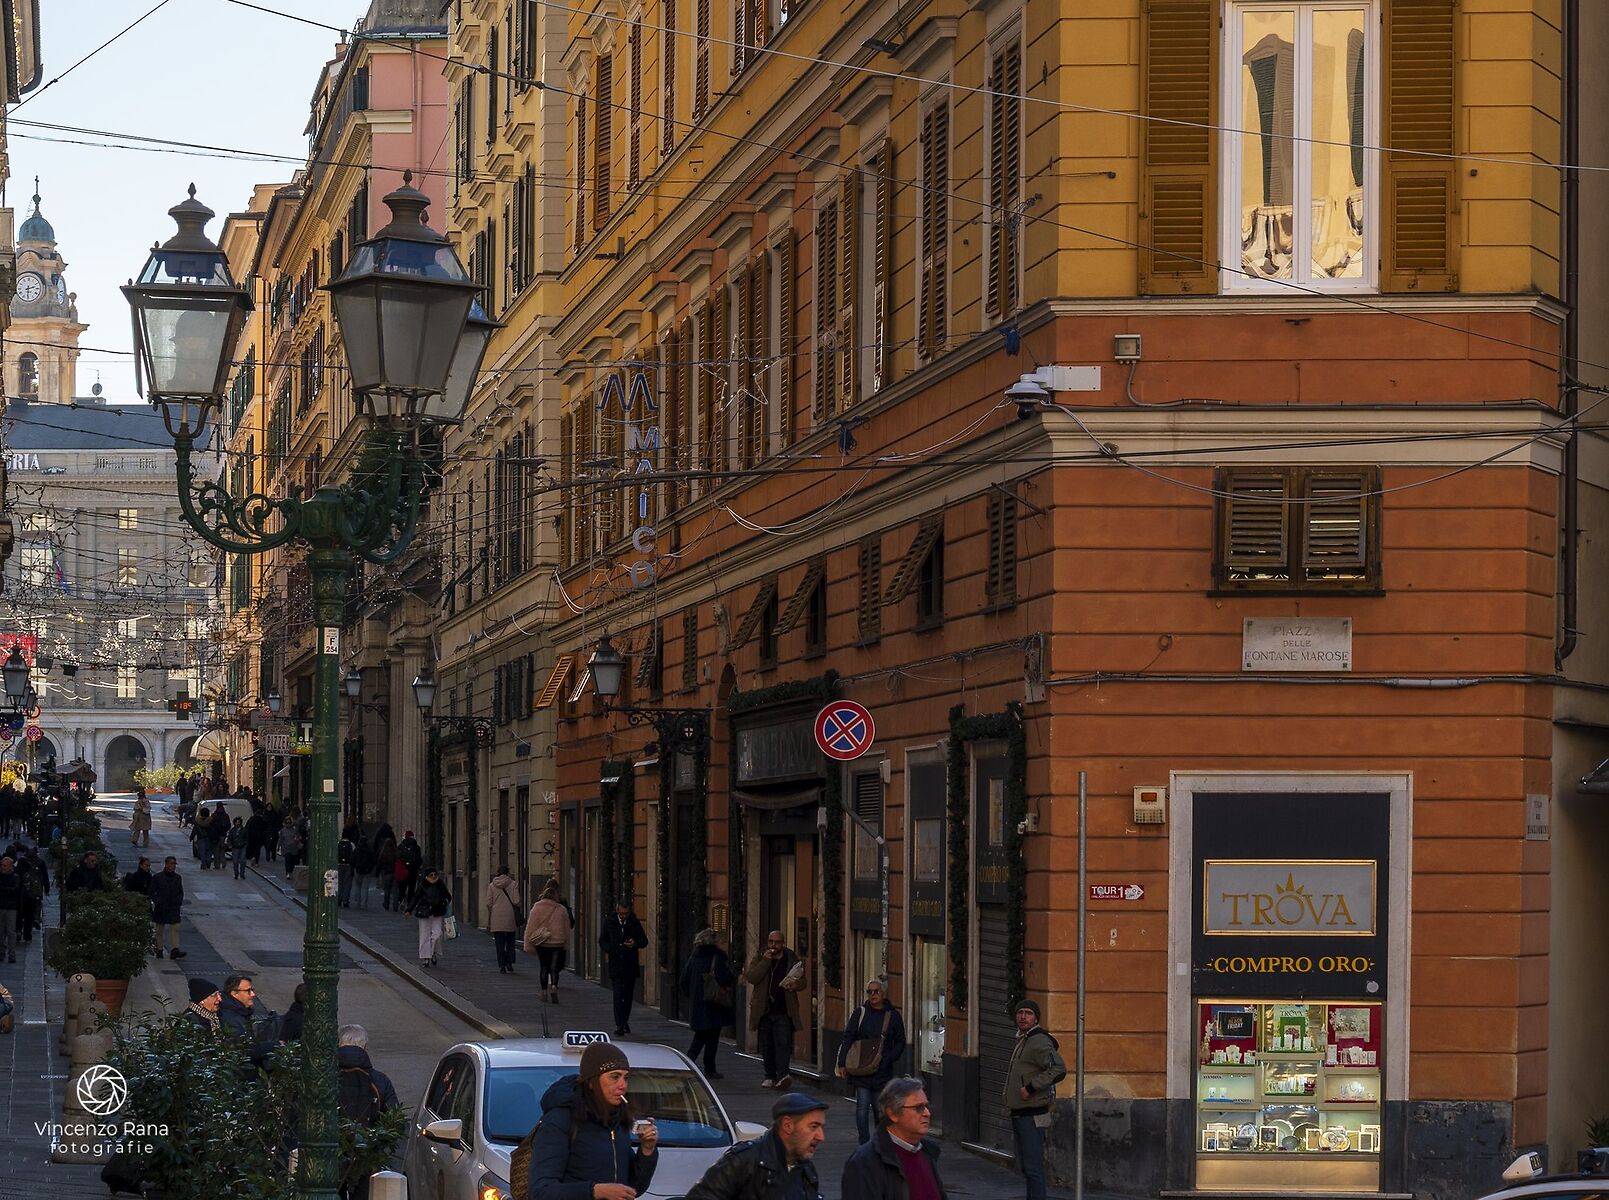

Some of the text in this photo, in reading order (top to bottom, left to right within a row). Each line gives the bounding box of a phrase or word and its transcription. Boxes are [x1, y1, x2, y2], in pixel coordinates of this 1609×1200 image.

[1272, 626, 1320, 637] PIAZZA
[329, 637, 336, 646] F
[1282, 639, 1312, 648] DELLE
[326, 645, 338, 653] 254
[1244, 650, 1350, 662] FONTANE MAROSE
[1091, 886, 1124, 898] TOUR 1
[1222, 893, 1356, 925] TROVA
[1214, 955, 1369, 973] COMPRO ORO
[568, 1034, 604, 1044] TAXI
